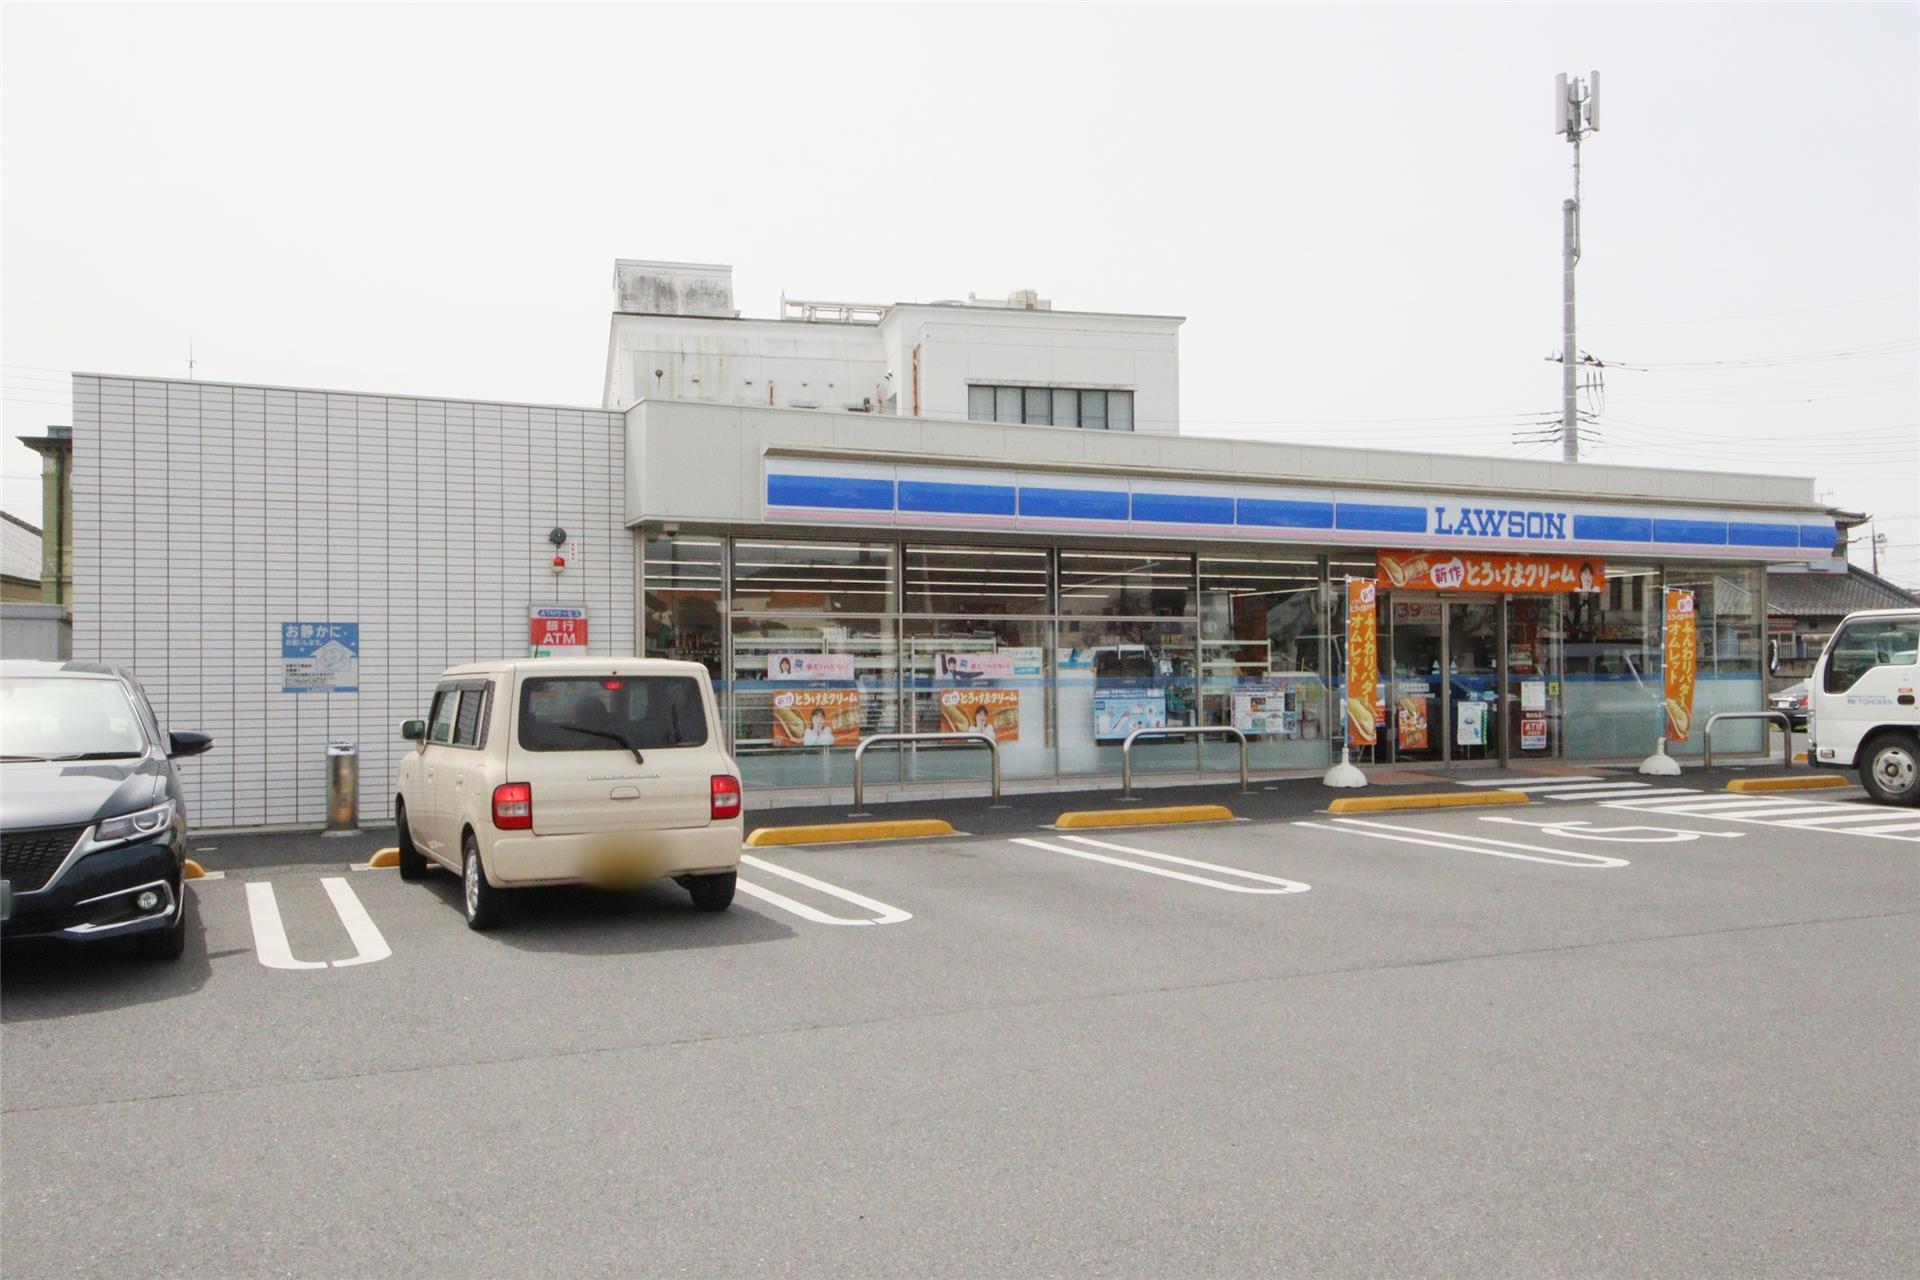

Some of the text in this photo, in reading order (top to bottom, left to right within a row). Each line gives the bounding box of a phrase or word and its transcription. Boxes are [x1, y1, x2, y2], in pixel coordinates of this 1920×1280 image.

[1435, 507, 1567, 540] LAWSON
[1433, 564, 1463, 585] 新作
[285, 625, 342, 639] お静かに
[546, 620, 575, 632] 銀行
[543, 632, 576, 645] ATM
[1350, 613, 1365, 683] オムレット
[1668, 621, 1682, 686] オムレット
